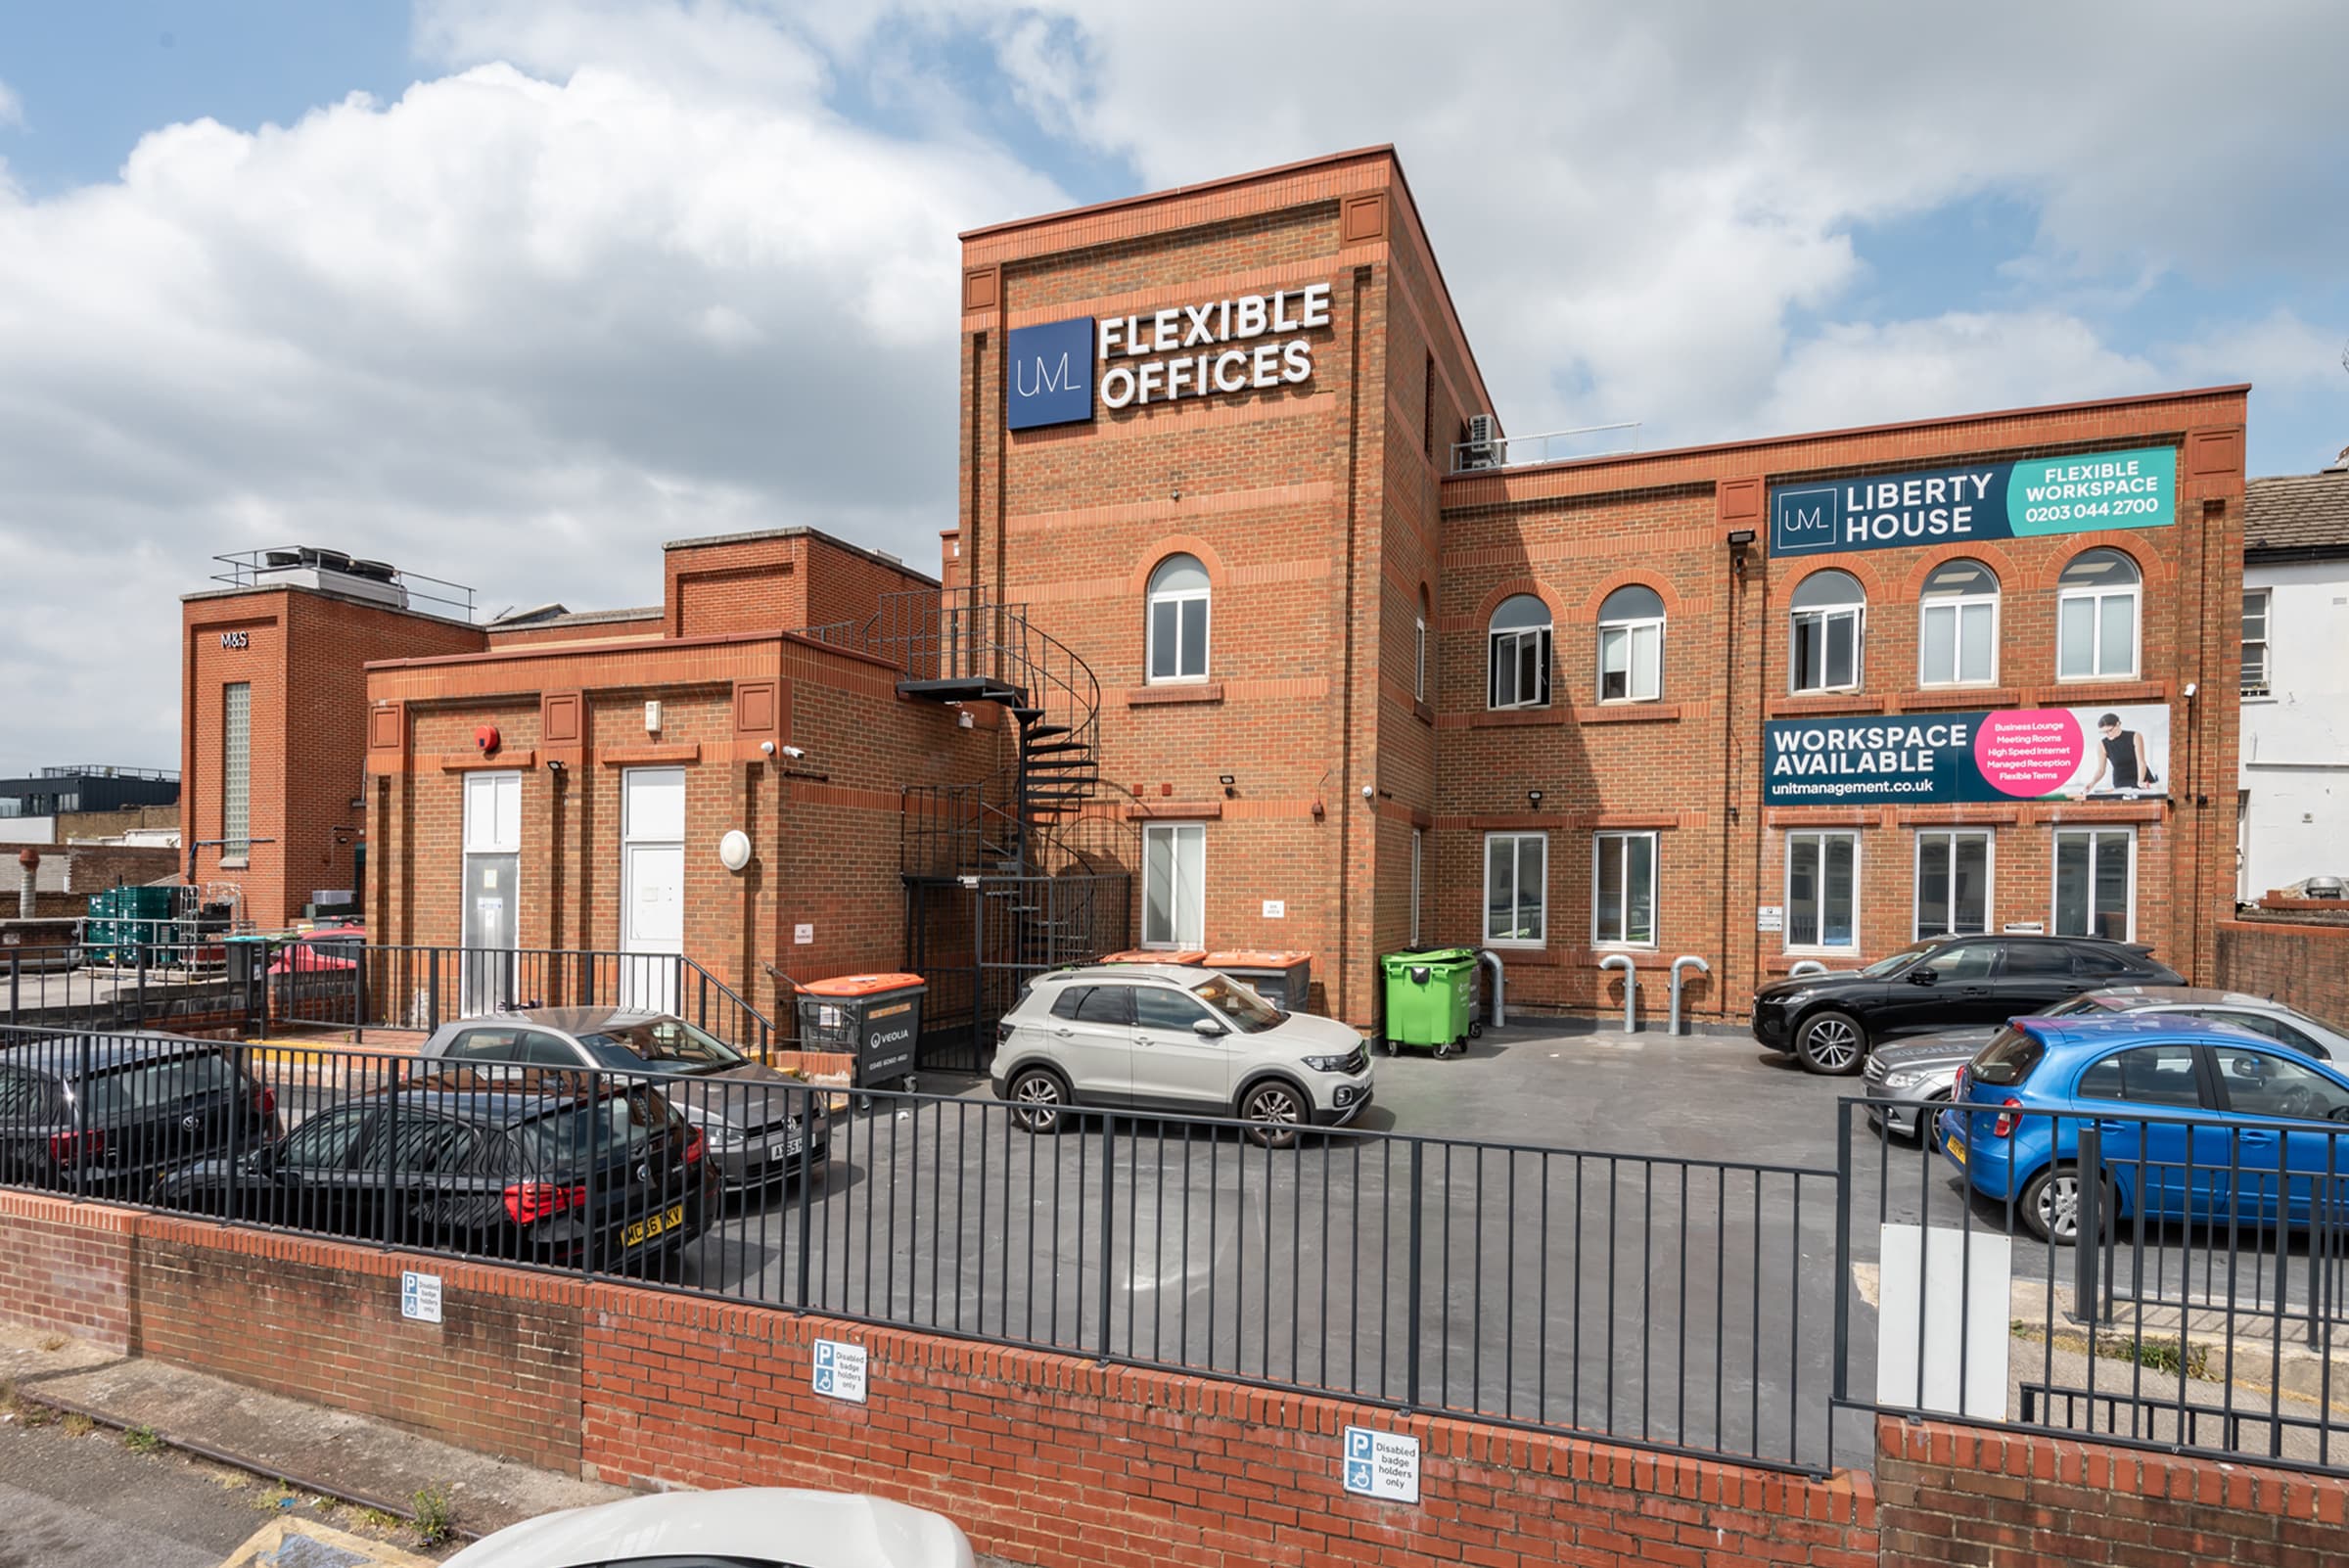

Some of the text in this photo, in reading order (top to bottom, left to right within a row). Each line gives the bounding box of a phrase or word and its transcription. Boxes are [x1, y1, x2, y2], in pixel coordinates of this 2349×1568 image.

[1099, 282, 1331, 360] FLEXIBLE
[1016, 351, 1082, 398] UML
[1100, 340, 1313, 409] OFFICES
[2045, 460, 2139, 484] FLEXIBLE
[1847, 472, 1993, 512] LIBERTY
[2026, 476, 2158, 502] WORKSPACE
[1785, 506, 1829, 531] UML
[2025, 497, 2159, 523] 0203 044 2700
[1846, 506, 1973, 542] HOUSE
[220, 630, 249, 649] M&S
[1995, 722, 2064, 732] Business Lounge
[1773, 723, 1968, 753] WORKSPACE
[1997, 734, 2061, 745] Meeting Rooms
[1988, 746, 2070, 758] High Speed Internet
[1773, 750, 1935, 776] AVAILABLE
[1987, 760, 2071, 769] Managed Reception
[1999, 771, 2057, 780] Flexible Terms
[1772, 778, 1934, 797] unitmanagement.co.uk
[882, 1029, 909, 1043] VEOLIA
[406, 1275, 416, 1292] P
[819, 1345, 831, 1363] P
[836, 1351, 864, 1363] Disabled
[840, 1361, 859, 1372] badge
[837, 1370, 861, 1381] holders
[842, 1381, 856, 1390] only
[1353, 1433, 1369, 1456] P
[1376, 1442, 1416, 1457] Disabled
[1381, 1454, 1409, 1467] badge
[1378, 1465, 1412, 1479] holders
[1386, 1477, 1405, 1489] only
